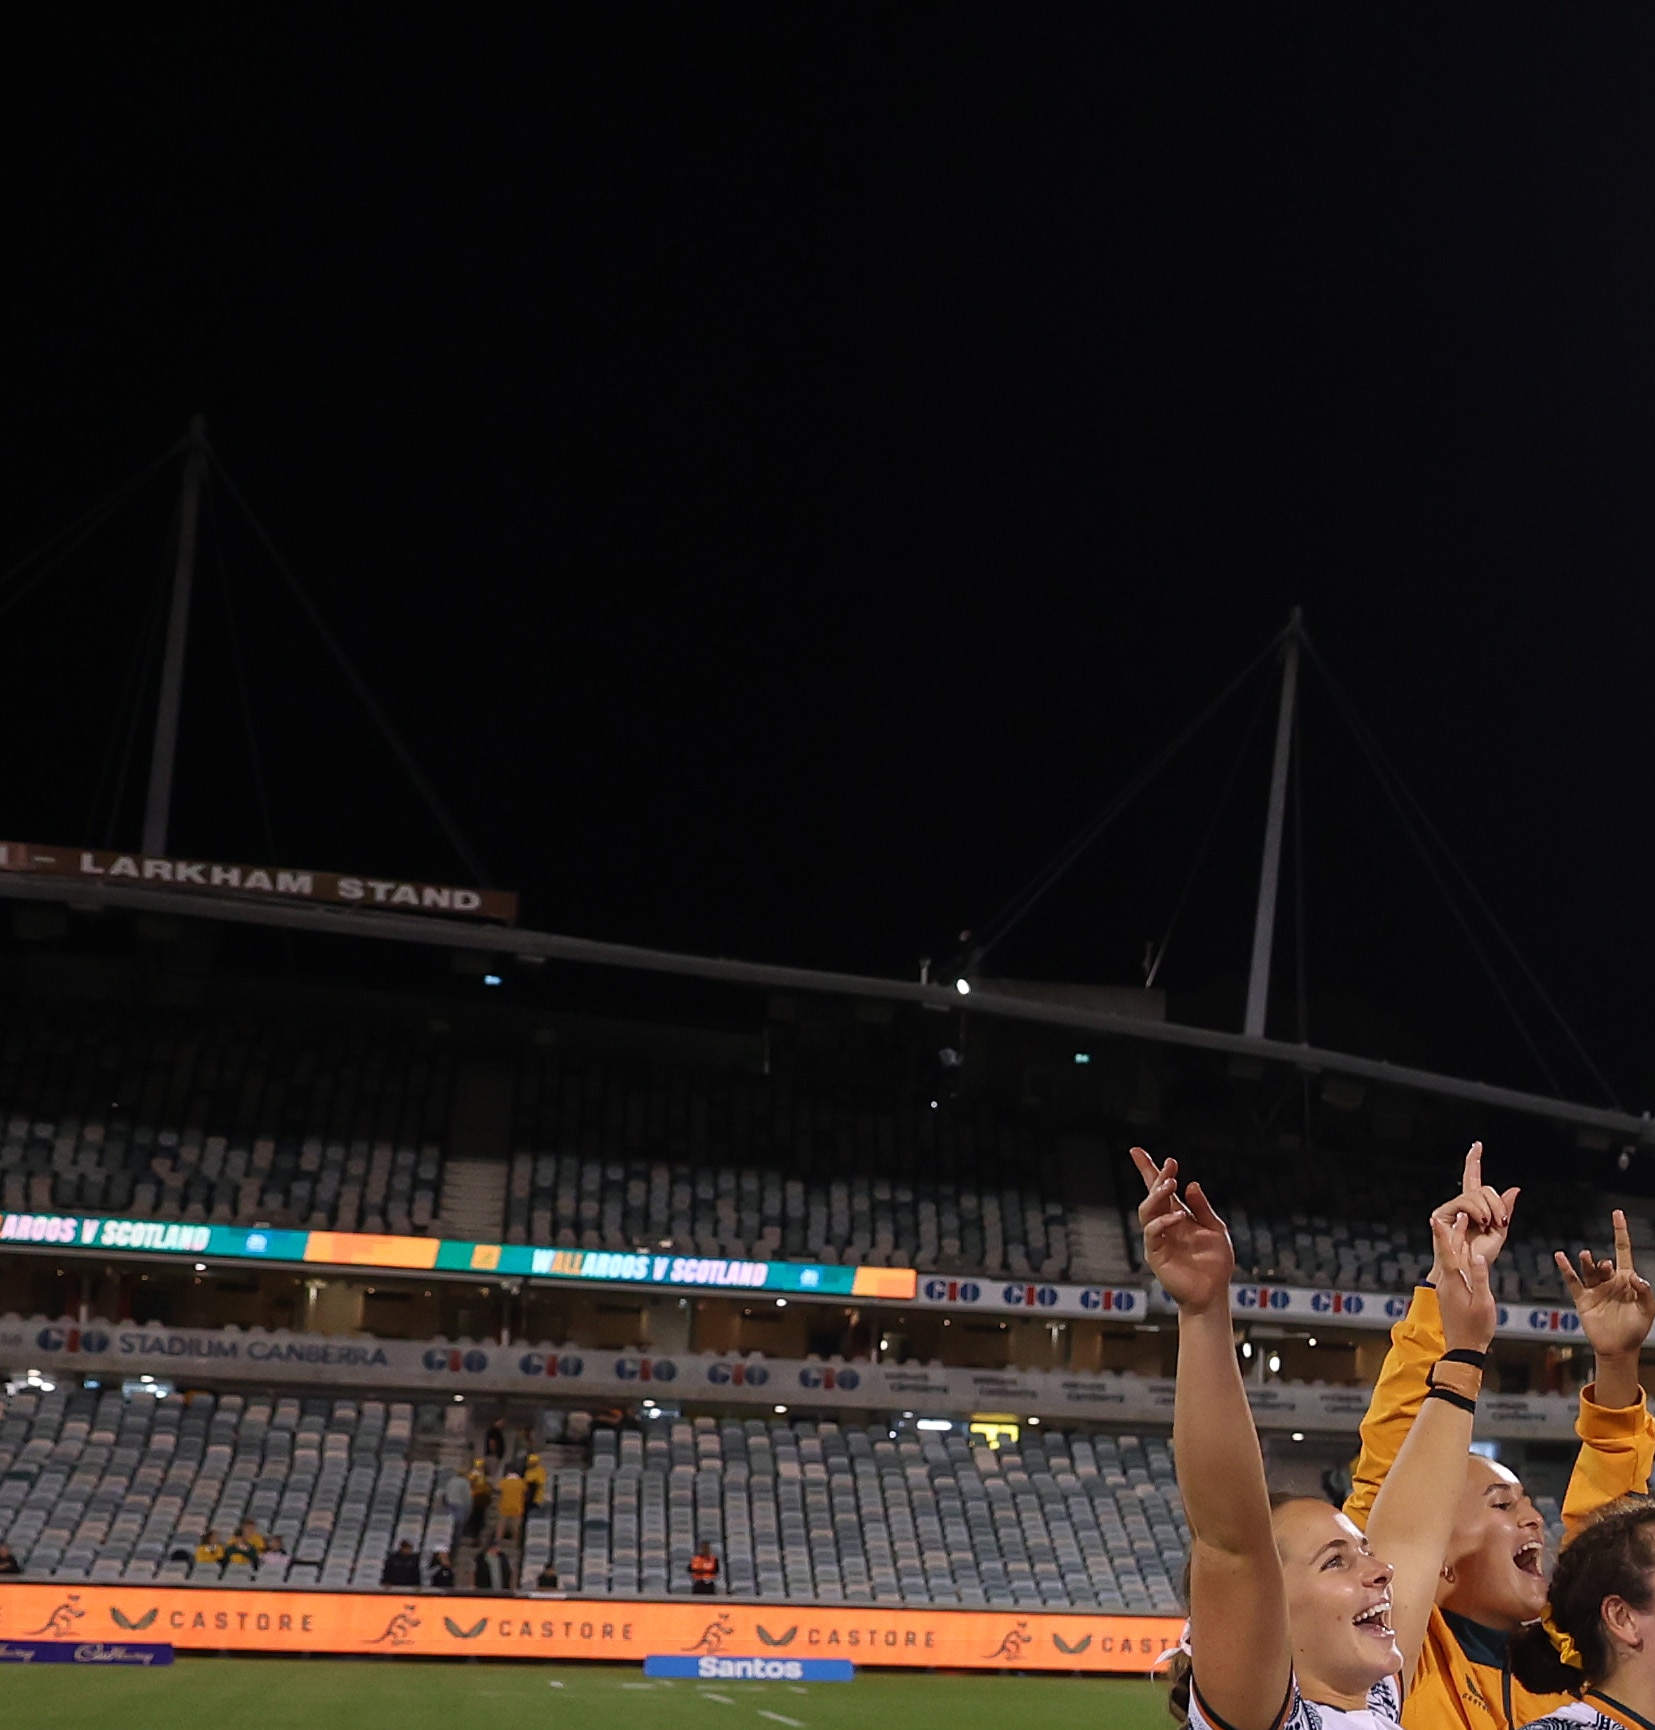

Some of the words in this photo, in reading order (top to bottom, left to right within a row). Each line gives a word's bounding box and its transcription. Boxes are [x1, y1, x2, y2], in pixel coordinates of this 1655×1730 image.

[80, 852, 313, 895] LARKHAM
[337, 878, 482, 912] STAND
[81, 1219, 99, 1245] V
[101, 1219, 211, 1251] SCOTLAND
[532, 1249, 650, 1279] WALLAROOS
[652, 1256, 669, 1281] V
[670, 1259, 768, 1287] SCOTLAND
[924, 1279, 981, 1303] GIO
[1003, 1282, 1058, 1307] GIO
[1079, 1288, 1136, 1312] GIO
[1236, 1286, 1291, 1312] GIO
[1310, 1291, 1365, 1316] GIO
[1529, 1309, 1580, 1332] GIO
[36, 1326, 109, 1354] GIO
[119, 1332, 241, 1358] STADIUM
[246, 1337, 389, 1366] CANBERRA
[169, 1611, 314, 1632] CASTORE
[499, 1620, 633, 1640] CASTORE
[807, 1629, 935, 1649] CASTORE
[1101, 1637, 1181, 1654] CAST
[698, 1655, 803, 1680] Santos
